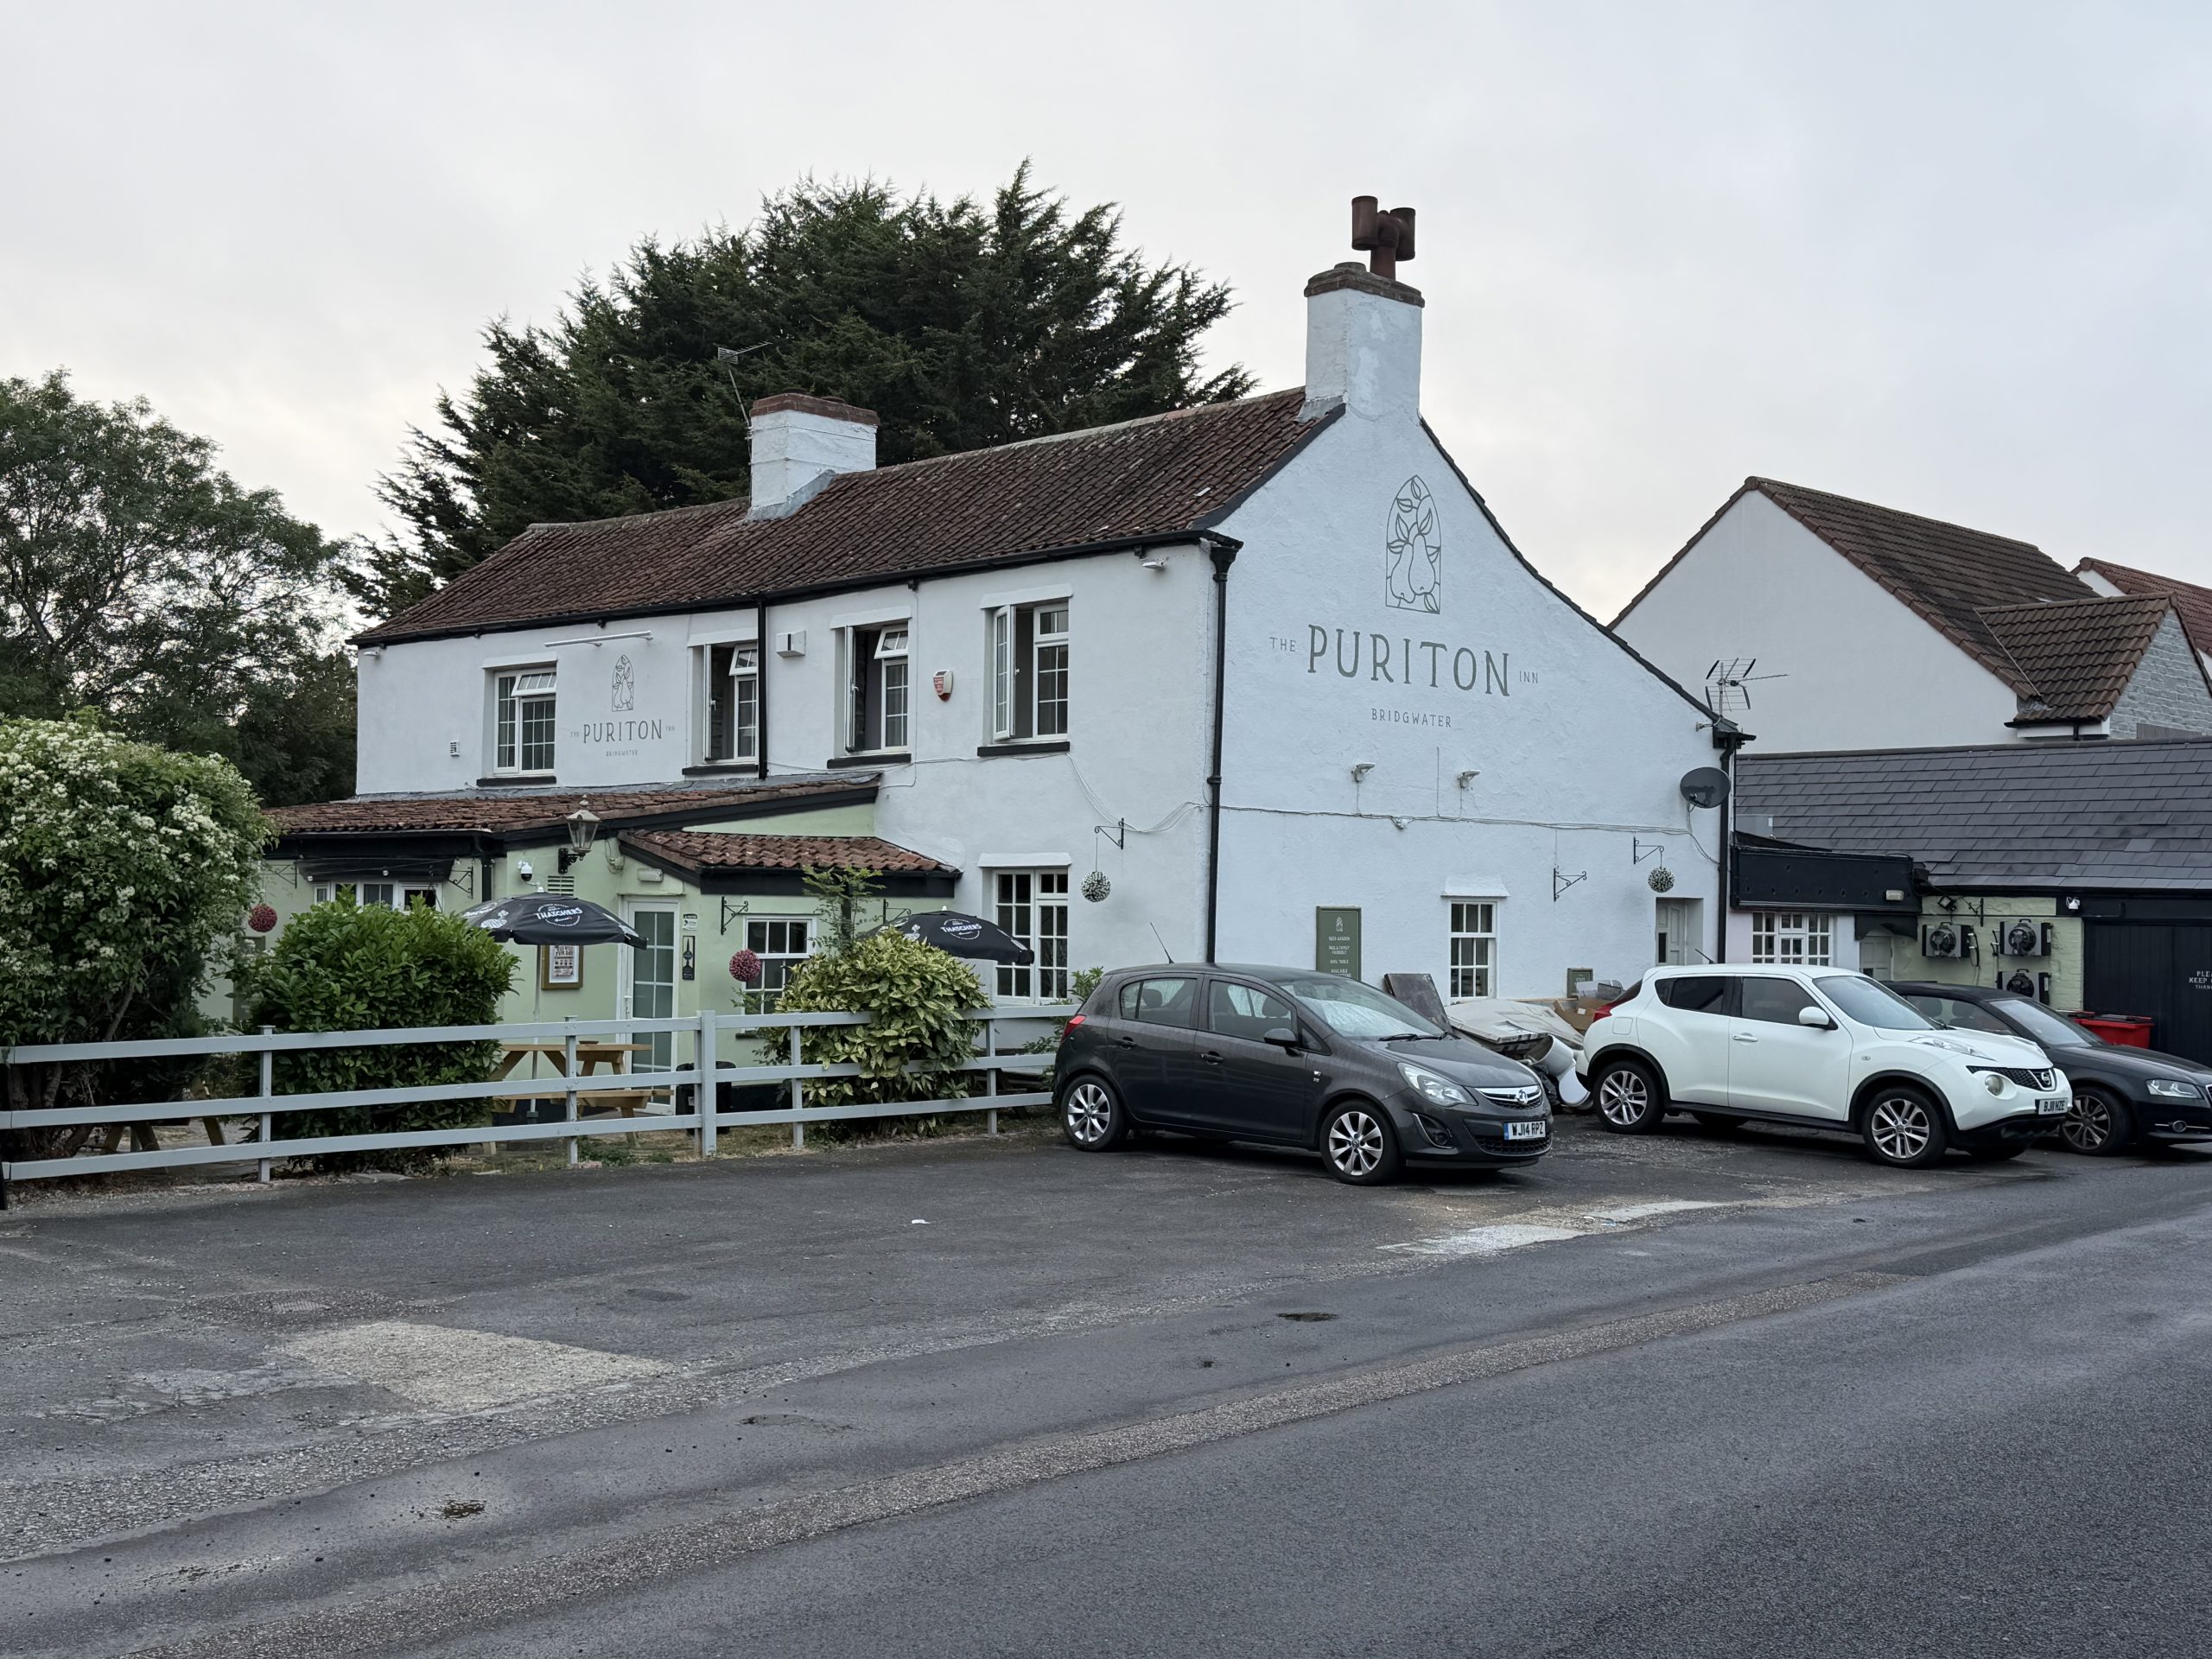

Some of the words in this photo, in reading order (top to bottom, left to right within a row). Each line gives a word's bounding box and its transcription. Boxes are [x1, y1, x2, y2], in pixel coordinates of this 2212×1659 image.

[1268, 636, 1297, 652] THE
[1307, 624, 1510, 696] PURITON
[1518, 670, 1540, 684] INN
[1371, 708, 1452, 728] BRIDGWATER
[583, 719, 662, 744] PURITON
[532, 907, 583, 920] THATCHERS
[940, 923, 982, 933] THATCHERS
[1512, 1123, 1530, 1136] WJ14
[1531, 1122, 1543, 1135] RPZ
